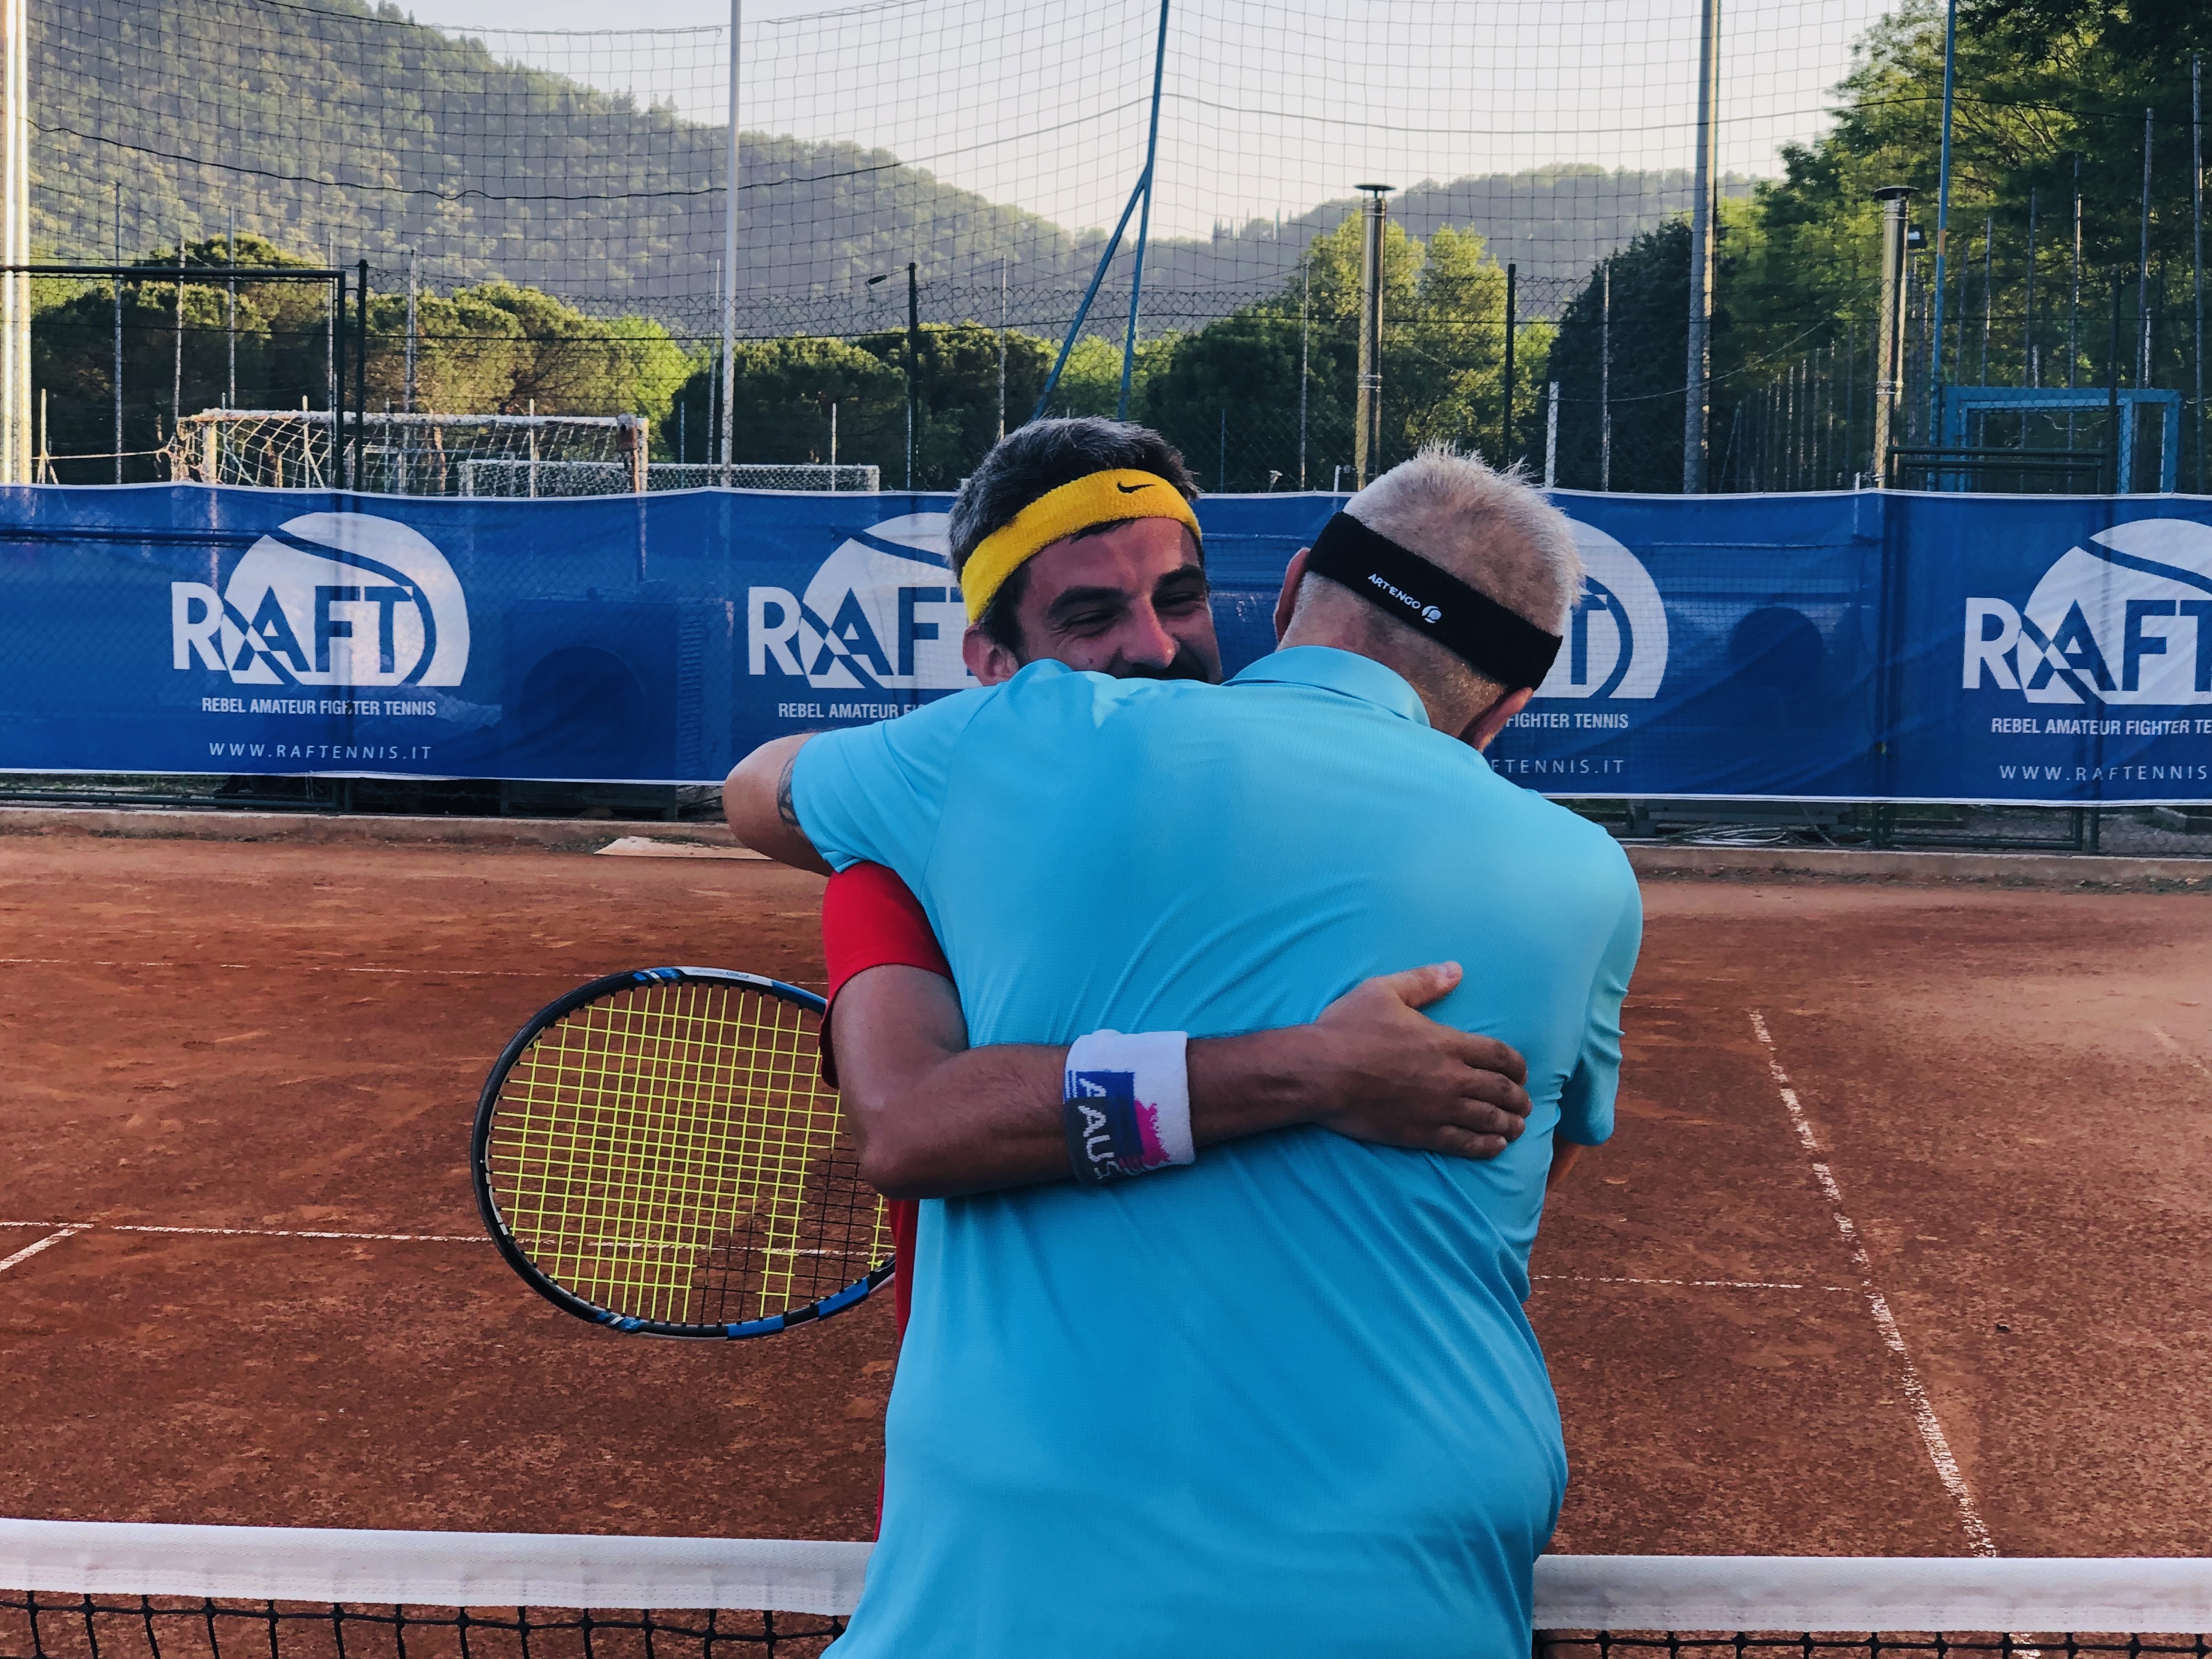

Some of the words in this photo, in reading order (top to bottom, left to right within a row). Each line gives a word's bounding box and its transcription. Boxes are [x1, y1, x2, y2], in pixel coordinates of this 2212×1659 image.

[1368, 573, 1421, 610] ARTENGO
[171, 582, 414, 674] RAFT
[748, 586, 968, 676] RAF
[201, 697, 246, 713] REBEL
[250, 698, 316, 715] AMATEUR
[383, 701, 437, 716] TENNIS
[778, 703, 825, 718] REBEL
[828, 703, 899, 719] AMATEUR
[1574, 713, 1629, 729] TENNIS
[1991, 718, 2041, 734] REBEL
[2045, 719, 2121, 735] AMATEUR
[2126, 719, 2190, 736] FIGHTER
[209, 742, 432, 759] WWW.RAFTENNIS.IT
